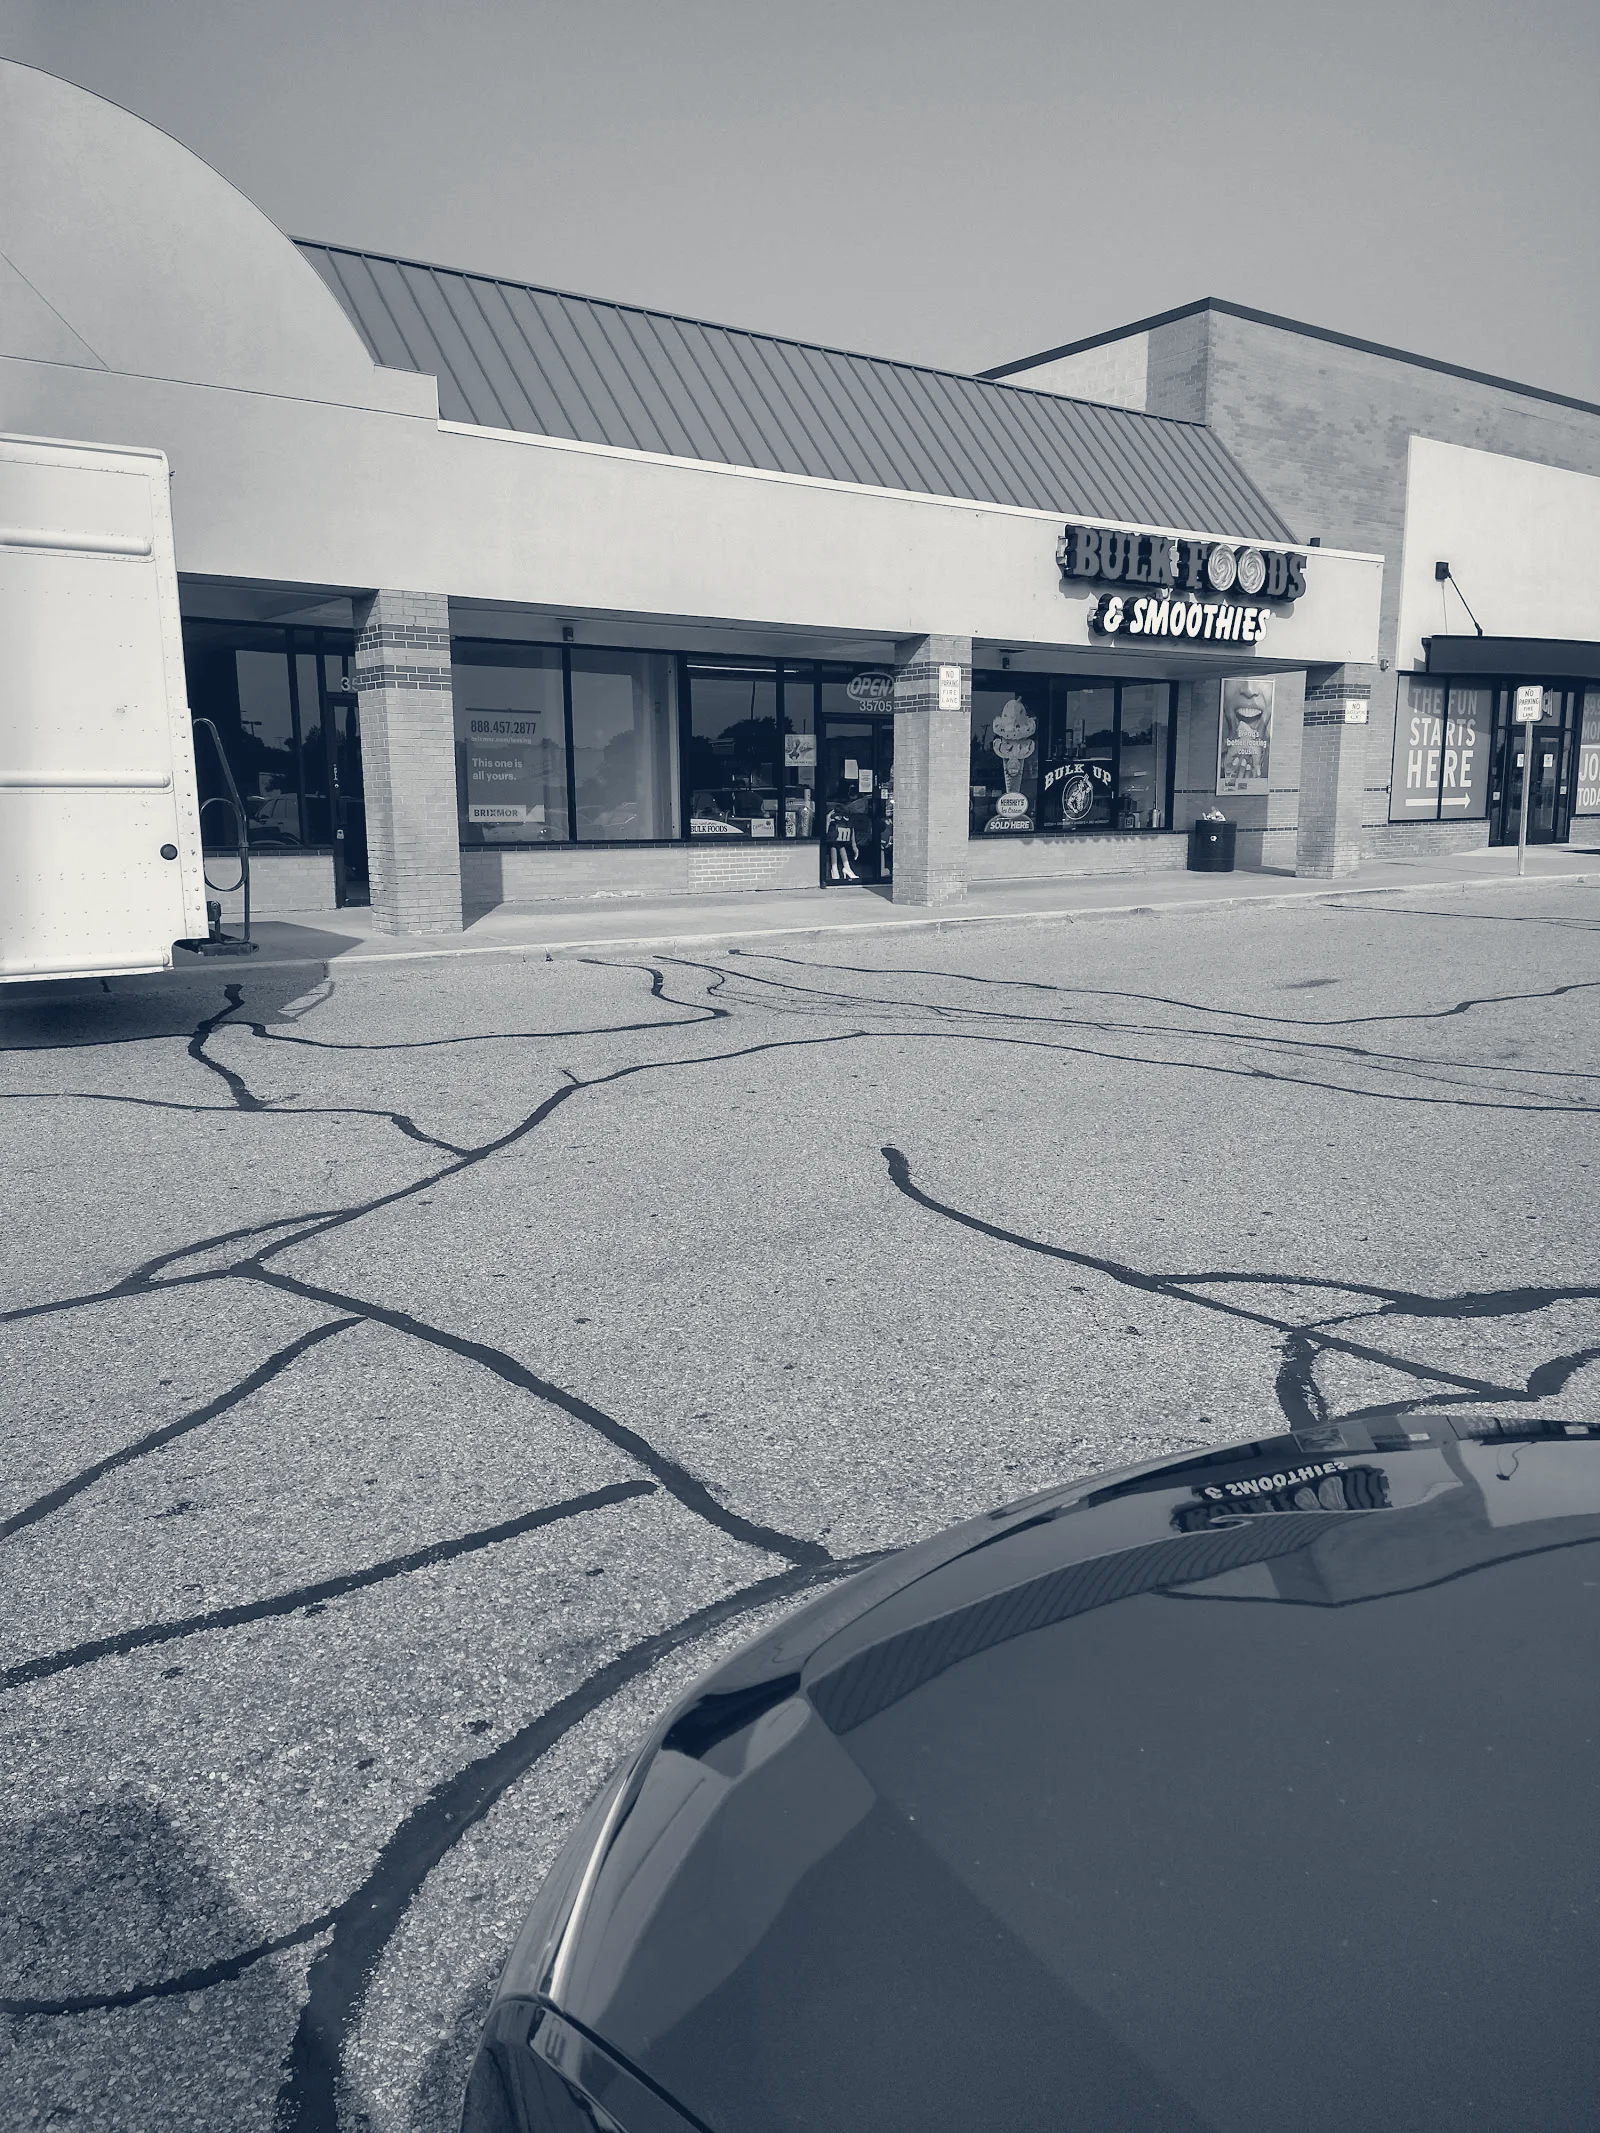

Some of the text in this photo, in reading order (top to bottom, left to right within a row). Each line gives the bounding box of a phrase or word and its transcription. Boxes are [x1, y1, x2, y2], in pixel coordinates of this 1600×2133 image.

[1073, 526, 1307, 599] BULK FOODS
[1103, 596, 1271, 642] & SMOOTHIES
[945, 670, 955, 679] NO
[850, 676, 891, 697] OPEN
[941, 679, 959, 688] PARKING
[859, 700, 892, 712] 35705
[1412, 688, 1478, 715] THE FUN
[470, 720, 537, 735] 888.457.2877
[1409, 717, 1477, 747] STARTS
[472, 758, 523, 768] This one is
[1406, 749, 1474, 788] HERE
[472, 771, 517, 782] all yours.
[1044, 763, 1112, 791] BULK UP
[1000, 798, 1025, 806] HERSHEY'S
[473, 808, 518, 817] BRIXMOR
[707, 825, 728, 833] FOODS
[990, 820, 1030, 829] SOLD HERE
